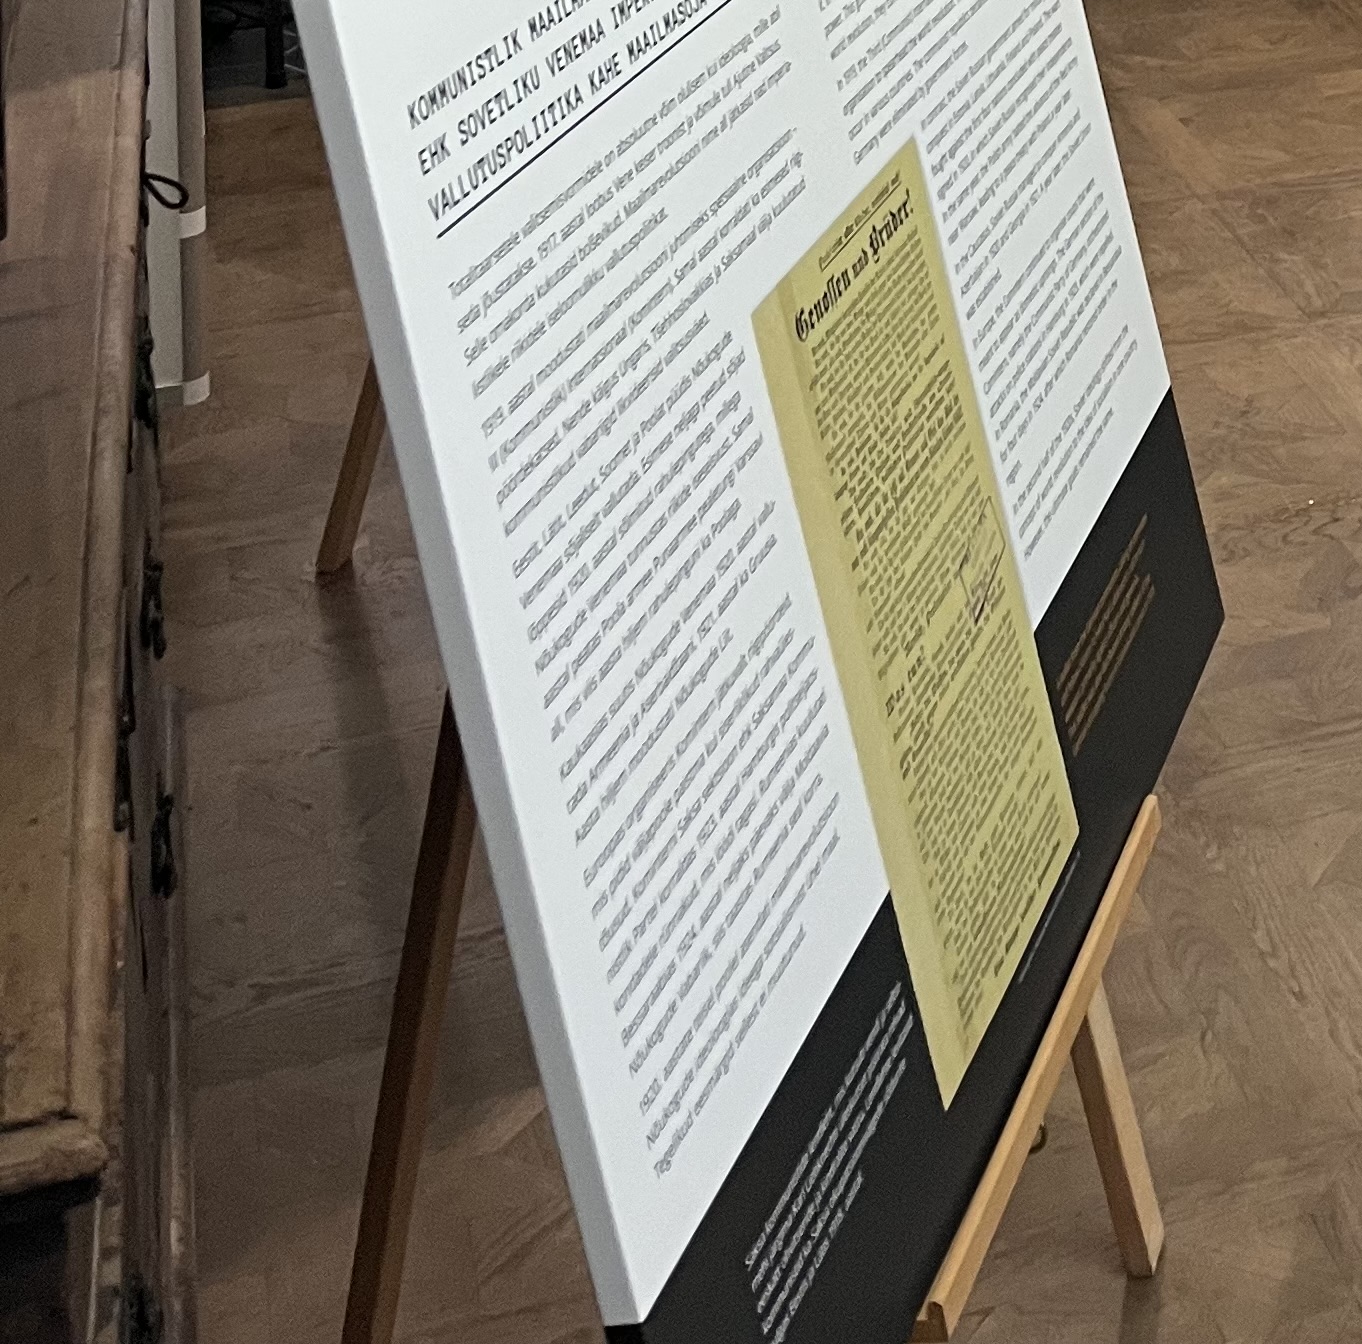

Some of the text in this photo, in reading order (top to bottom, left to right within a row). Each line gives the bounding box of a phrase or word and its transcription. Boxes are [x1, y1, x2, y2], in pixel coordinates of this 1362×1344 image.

[406, 27, 524, 131] KOMMUNISTLIK
[417, 131, 452, 177] EHK
[457, 64, 541, 148] SOVETLIKU
[544, 17, 607, 78] VENEMAA
[427, 83, 585, 222] VALLUTUSPOLIITIKA
[587, 51, 623, 97] KAHE
[851, 247, 870, 280] und
